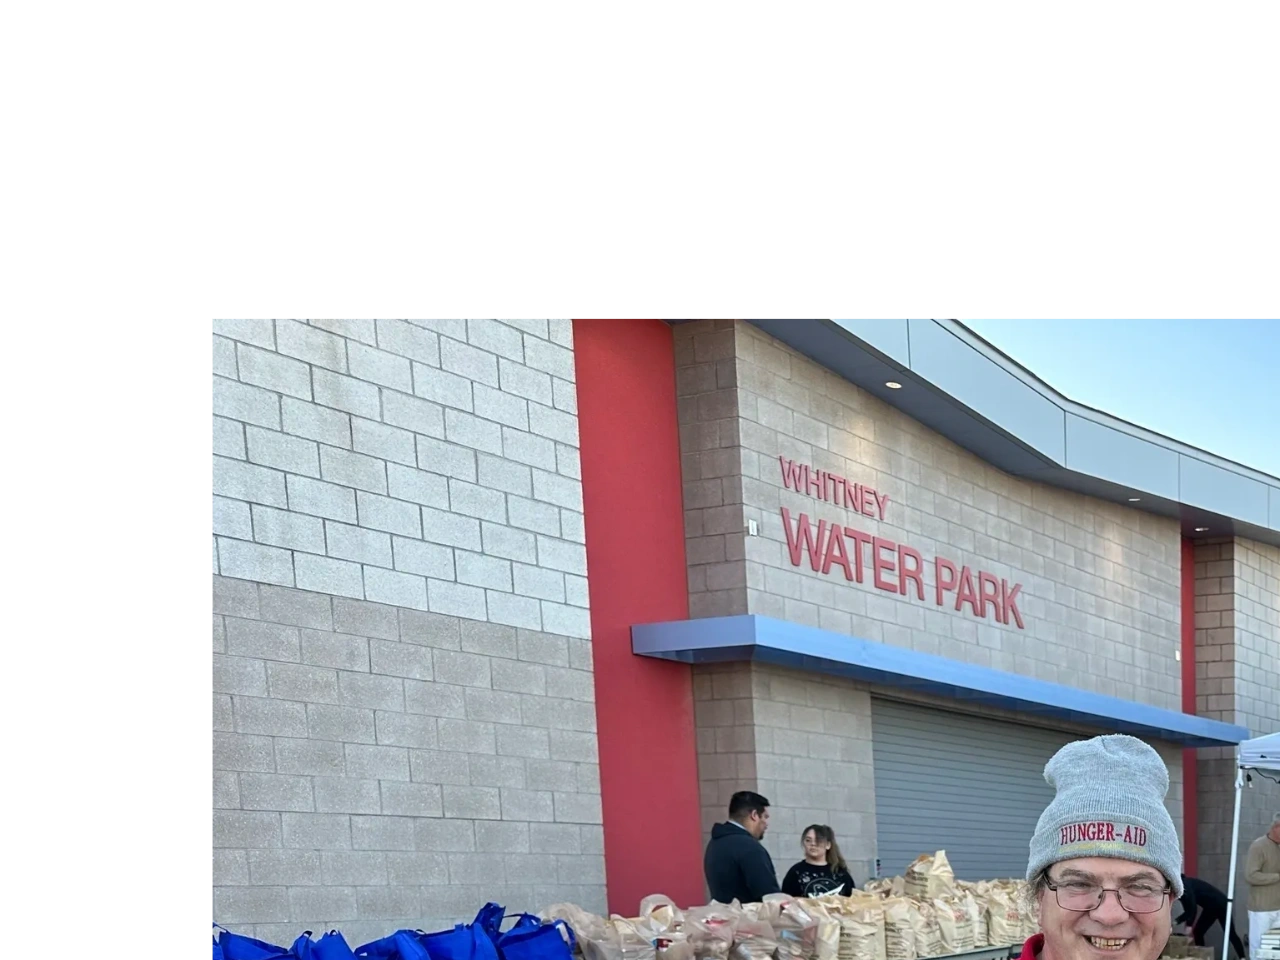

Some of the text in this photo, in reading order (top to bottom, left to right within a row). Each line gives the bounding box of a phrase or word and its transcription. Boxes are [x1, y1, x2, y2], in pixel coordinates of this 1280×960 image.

[779, 456, 889, 520] WHITNEY
[780, 507, 1025, 629] WATER PARK
[1060, 822, 1147, 847] HUNGER-AID
